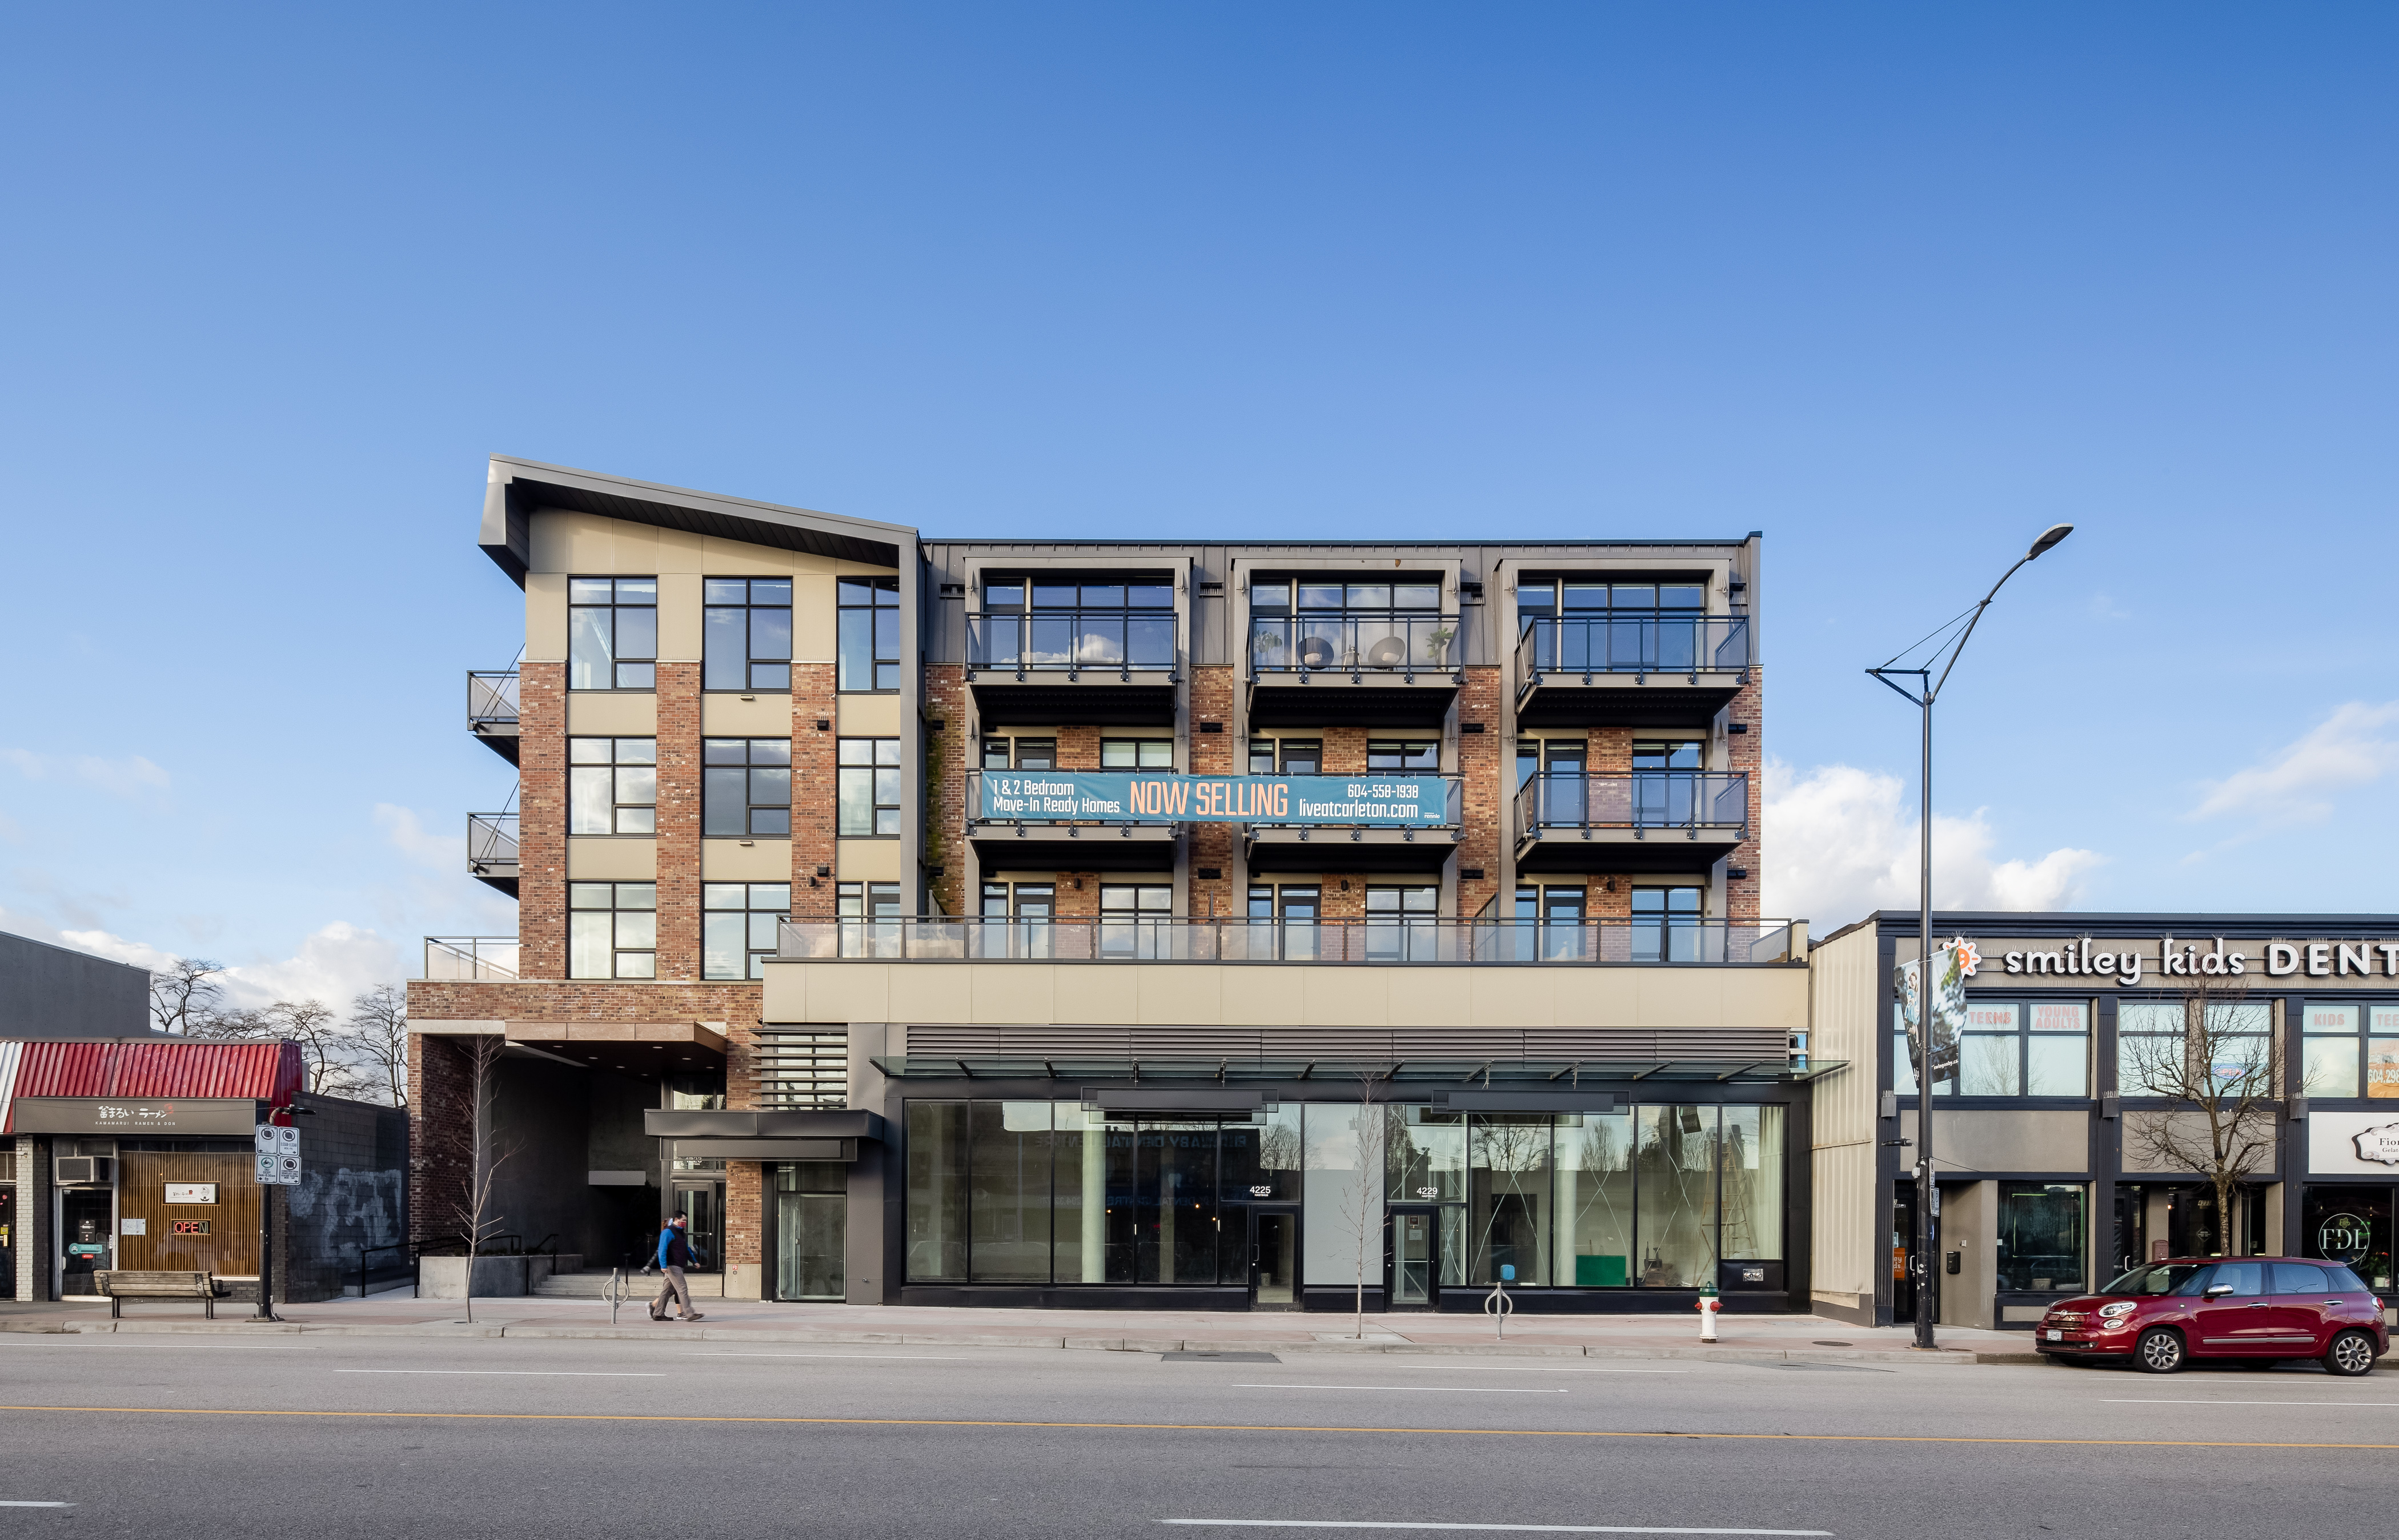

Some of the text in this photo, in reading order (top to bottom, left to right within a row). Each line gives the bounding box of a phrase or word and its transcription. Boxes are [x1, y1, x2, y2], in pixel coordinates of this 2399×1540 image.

[993, 779, 1074, 795] 1 & 2 Bedroom
[1348, 784, 1419, 798] 604-558-1938
[994, 796, 1120, 815] Move-In Ready Homes
[1130, 781, 1288, 816] NOW SELLING
[1299, 799, 1418, 818] liveatcarleton.com
[2005, 938, 2399, 985] smiley kids DENT
[1969, 1012, 2012, 1024] TEENS
[2037, 1006, 2079, 1017] YOUNG
[2035, 1017, 2080, 1028] ADULTS
[2314, 1013, 2345, 1025] KIDS
[98, 1106, 134, 1118] 釜まるい
[139, 1108, 167, 1118] ラーメン
[175, 1222, 206, 1233] OPEN
[2322, 1229, 2366, 1249] FDL
